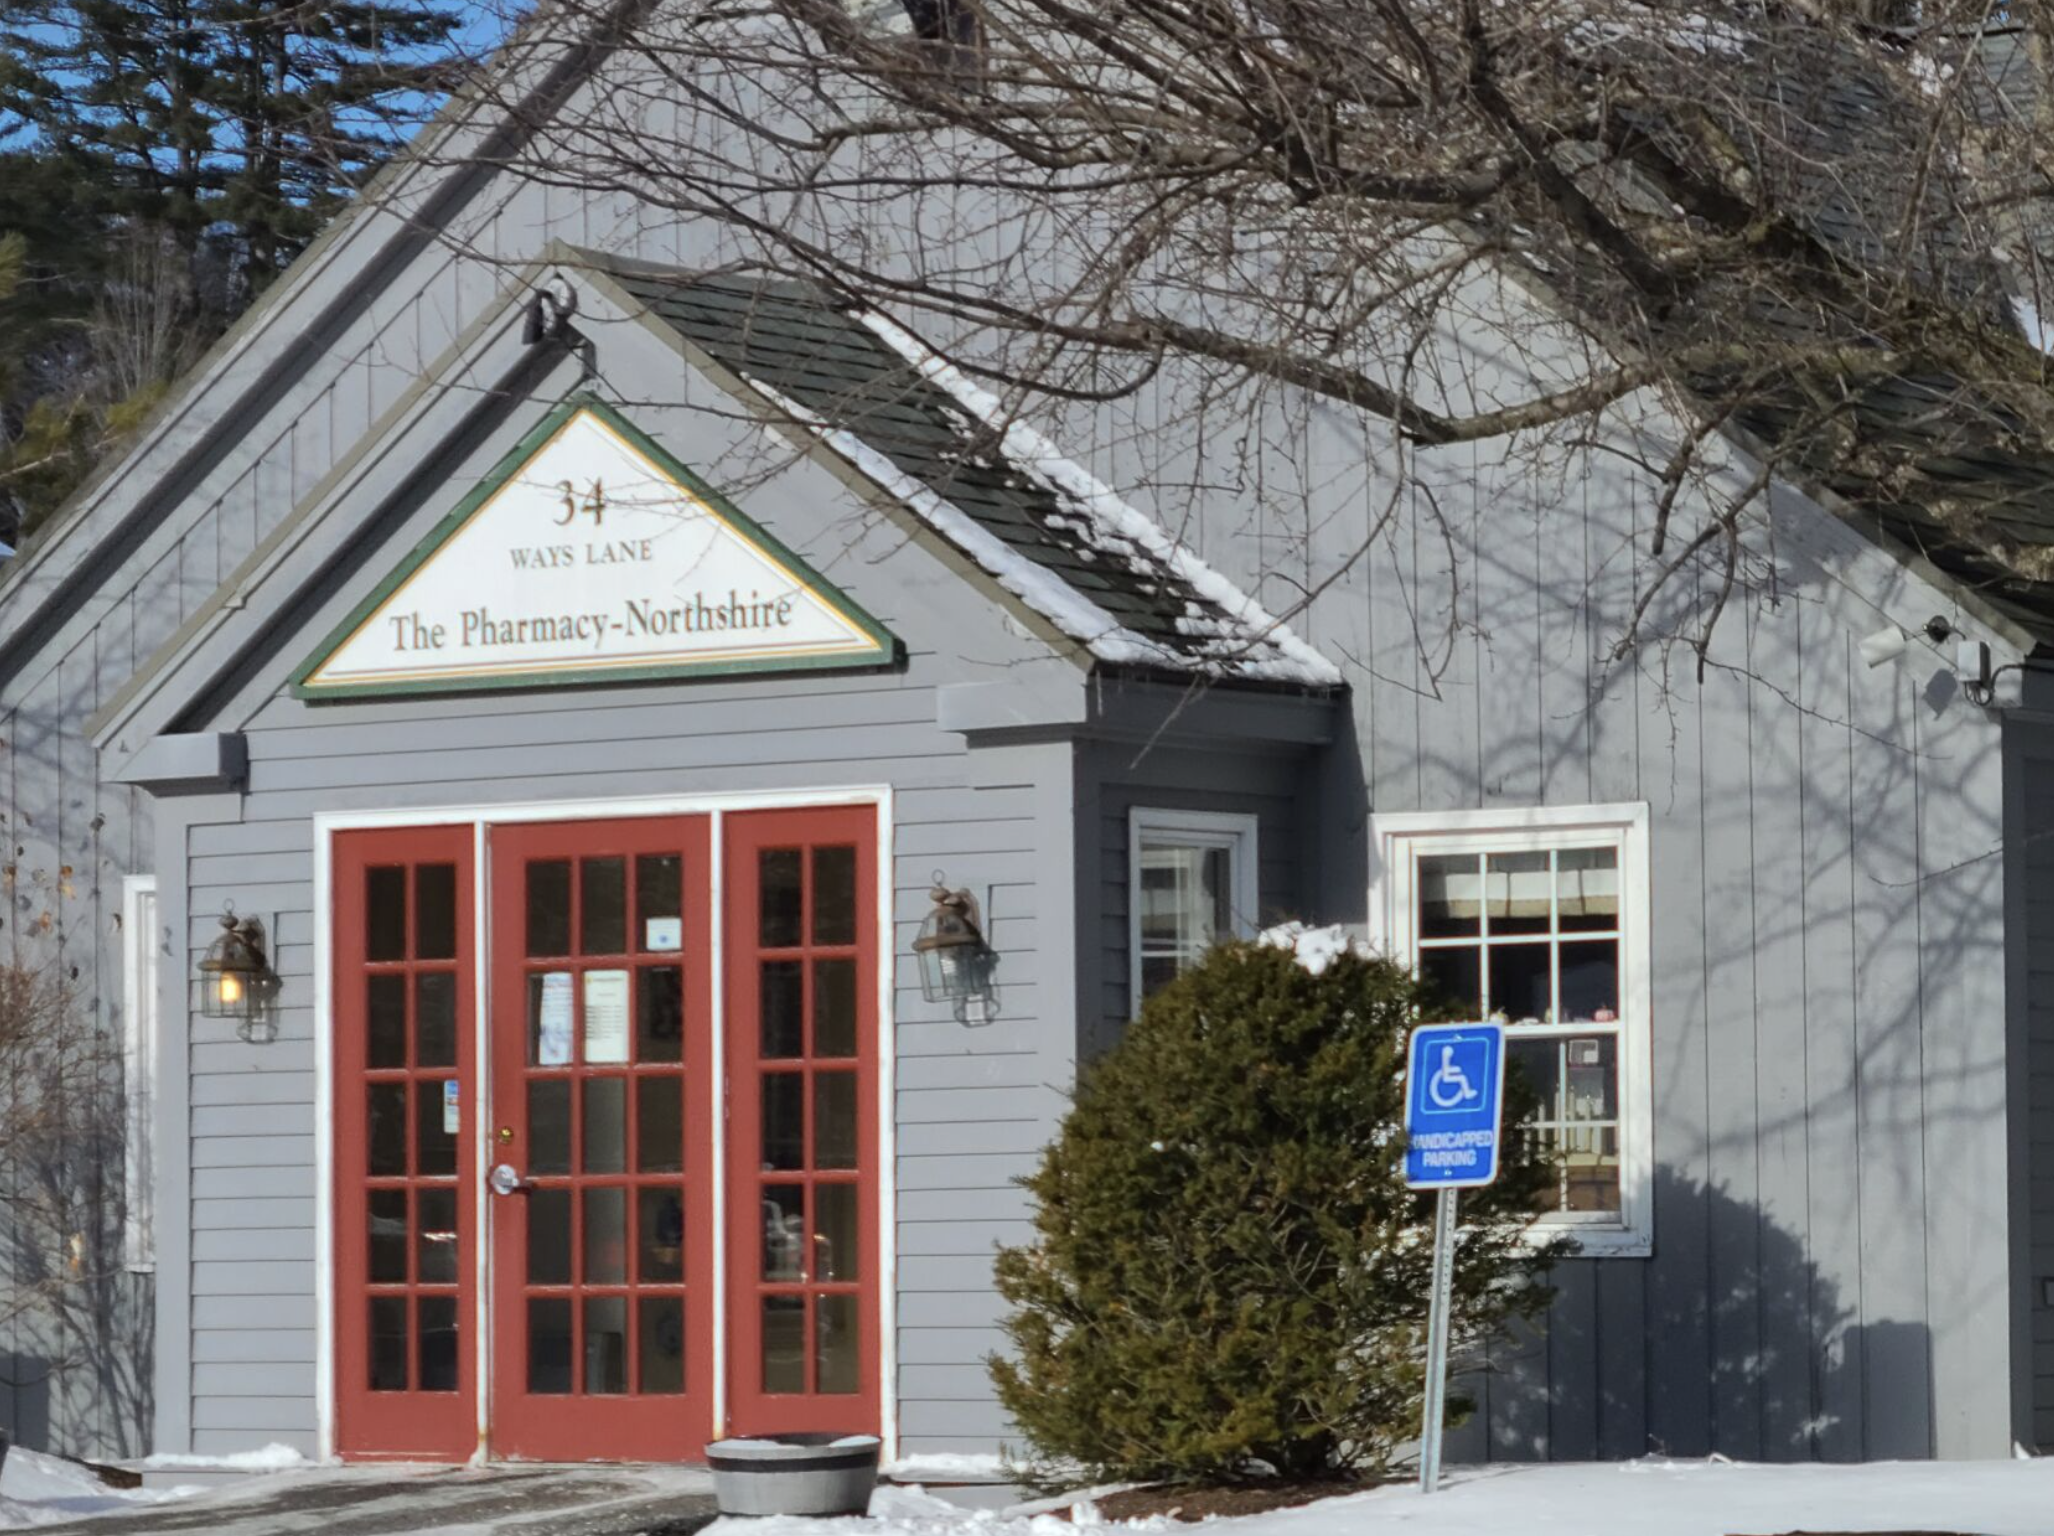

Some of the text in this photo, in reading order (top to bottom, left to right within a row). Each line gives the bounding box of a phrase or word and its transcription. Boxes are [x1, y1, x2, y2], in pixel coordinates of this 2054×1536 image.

[553, 477, 606, 526] 34
[510, 540, 653, 570] WAYS LANE
[390, 611, 446, 652] The
[1422, 1149, 1477, 1167] PARKING
